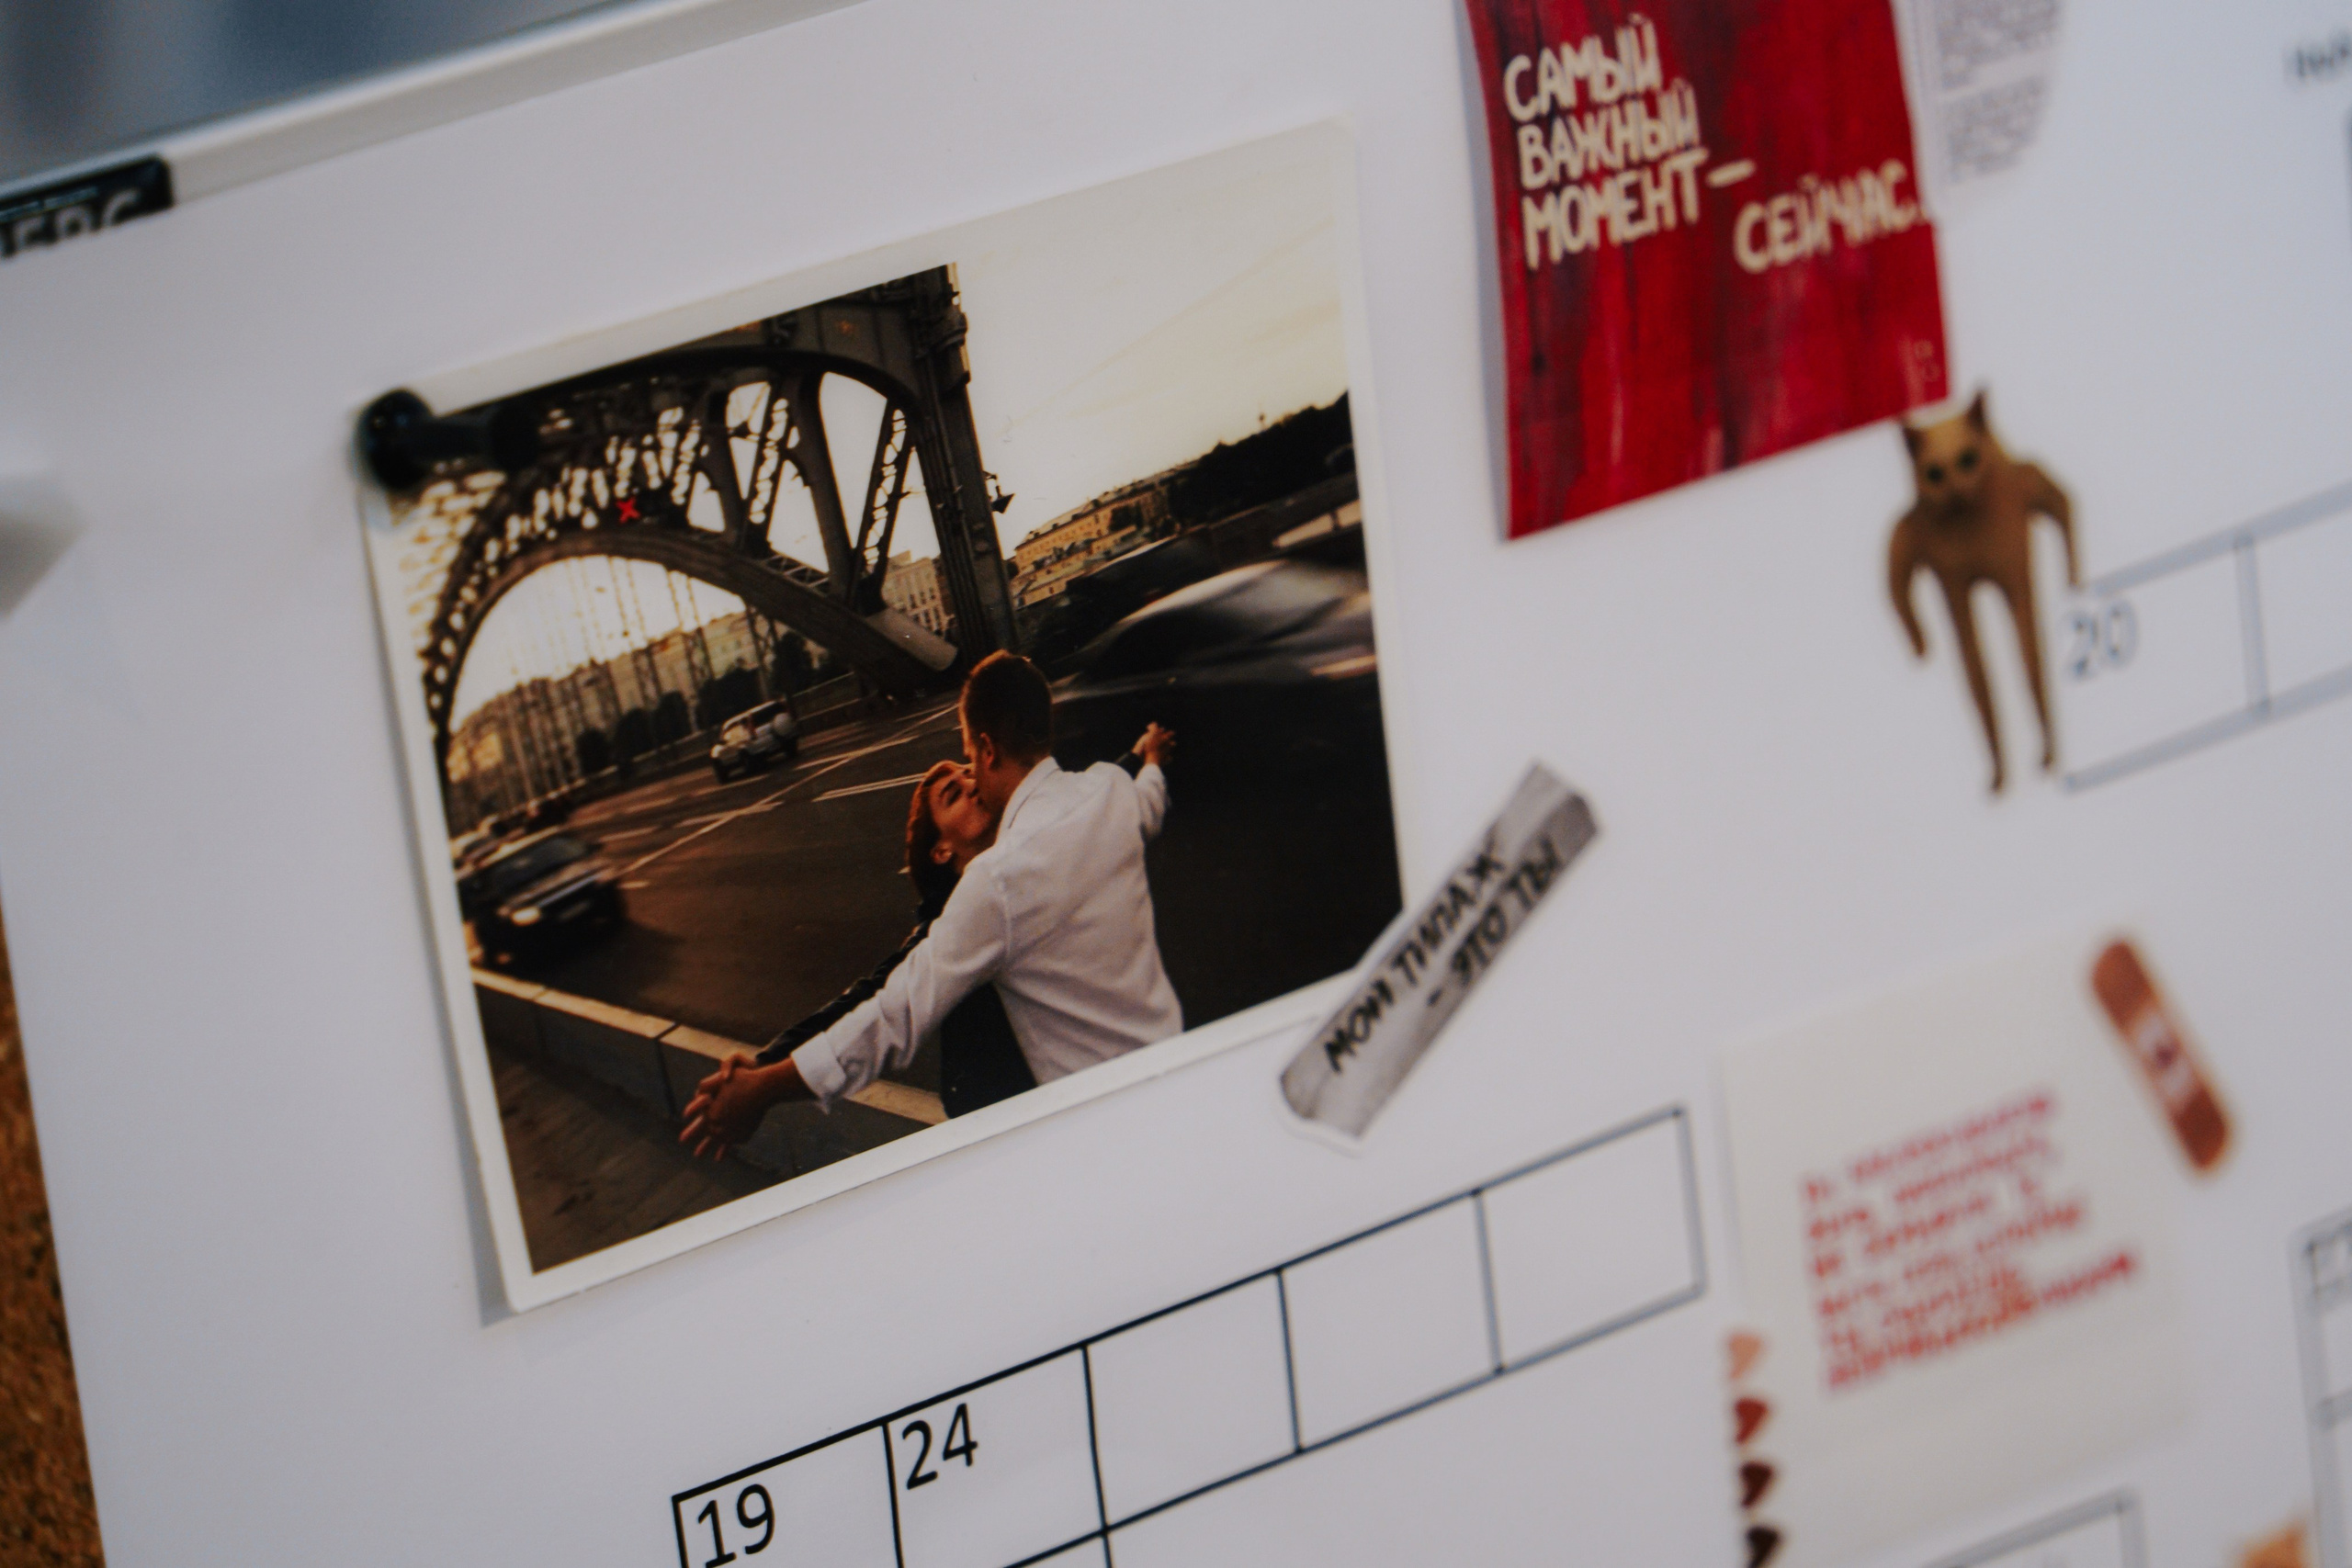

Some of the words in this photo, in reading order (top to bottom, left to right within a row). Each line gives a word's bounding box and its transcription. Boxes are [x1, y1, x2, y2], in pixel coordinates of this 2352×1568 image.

[1504, 12, 1664, 122] САМЫЙ
[1517, 77, 1702, 190] ВАЖНЫЙ
[2069, 600, 2138, 681] 20
[1451, 903, 1509, 987] ЭТО
[1506, 834, 1561, 909] ТЫ
[901, 1402, 978, 1490] 24
[696, 1483, 775, 1568] 19
